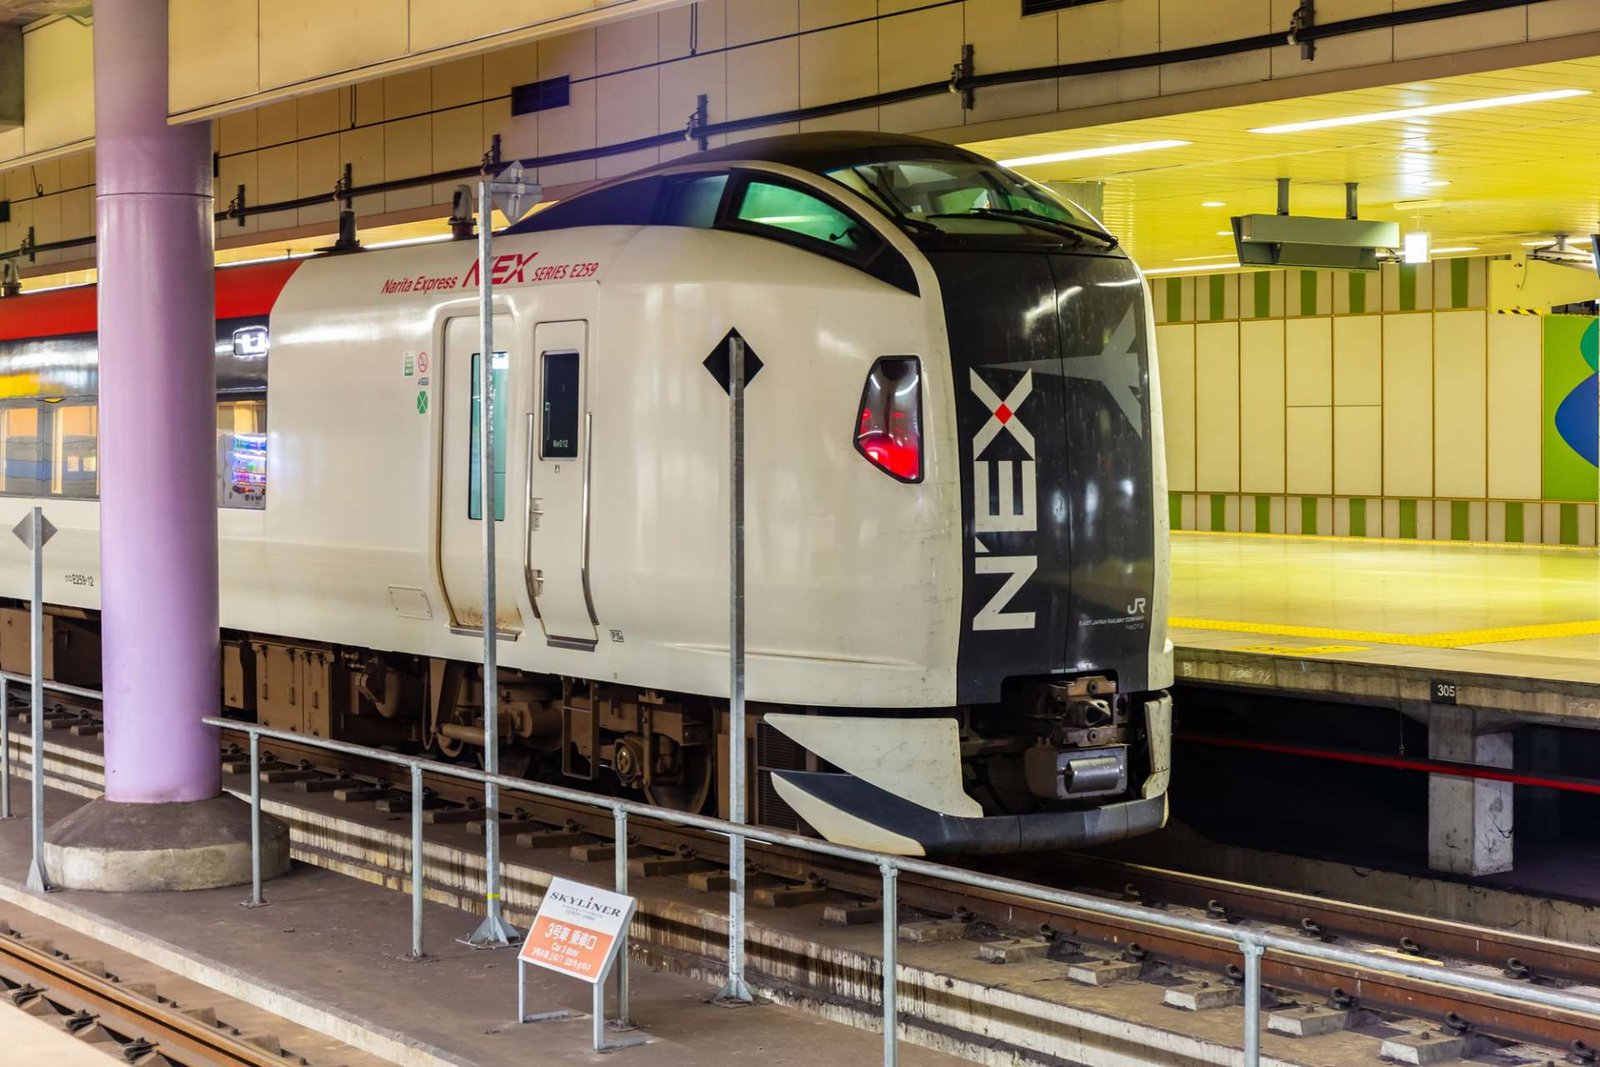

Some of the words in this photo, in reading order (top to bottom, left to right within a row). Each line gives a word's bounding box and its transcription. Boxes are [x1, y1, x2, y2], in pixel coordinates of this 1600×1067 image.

[381, 279, 412, 294] Narita
[413, 275, 458, 294] Express
[532, 266, 567, 282] SERIES
[569, 262, 599, 278] E259
[1127, 597, 1146, 615] JR
[1437, 684, 1456, 697] 305
